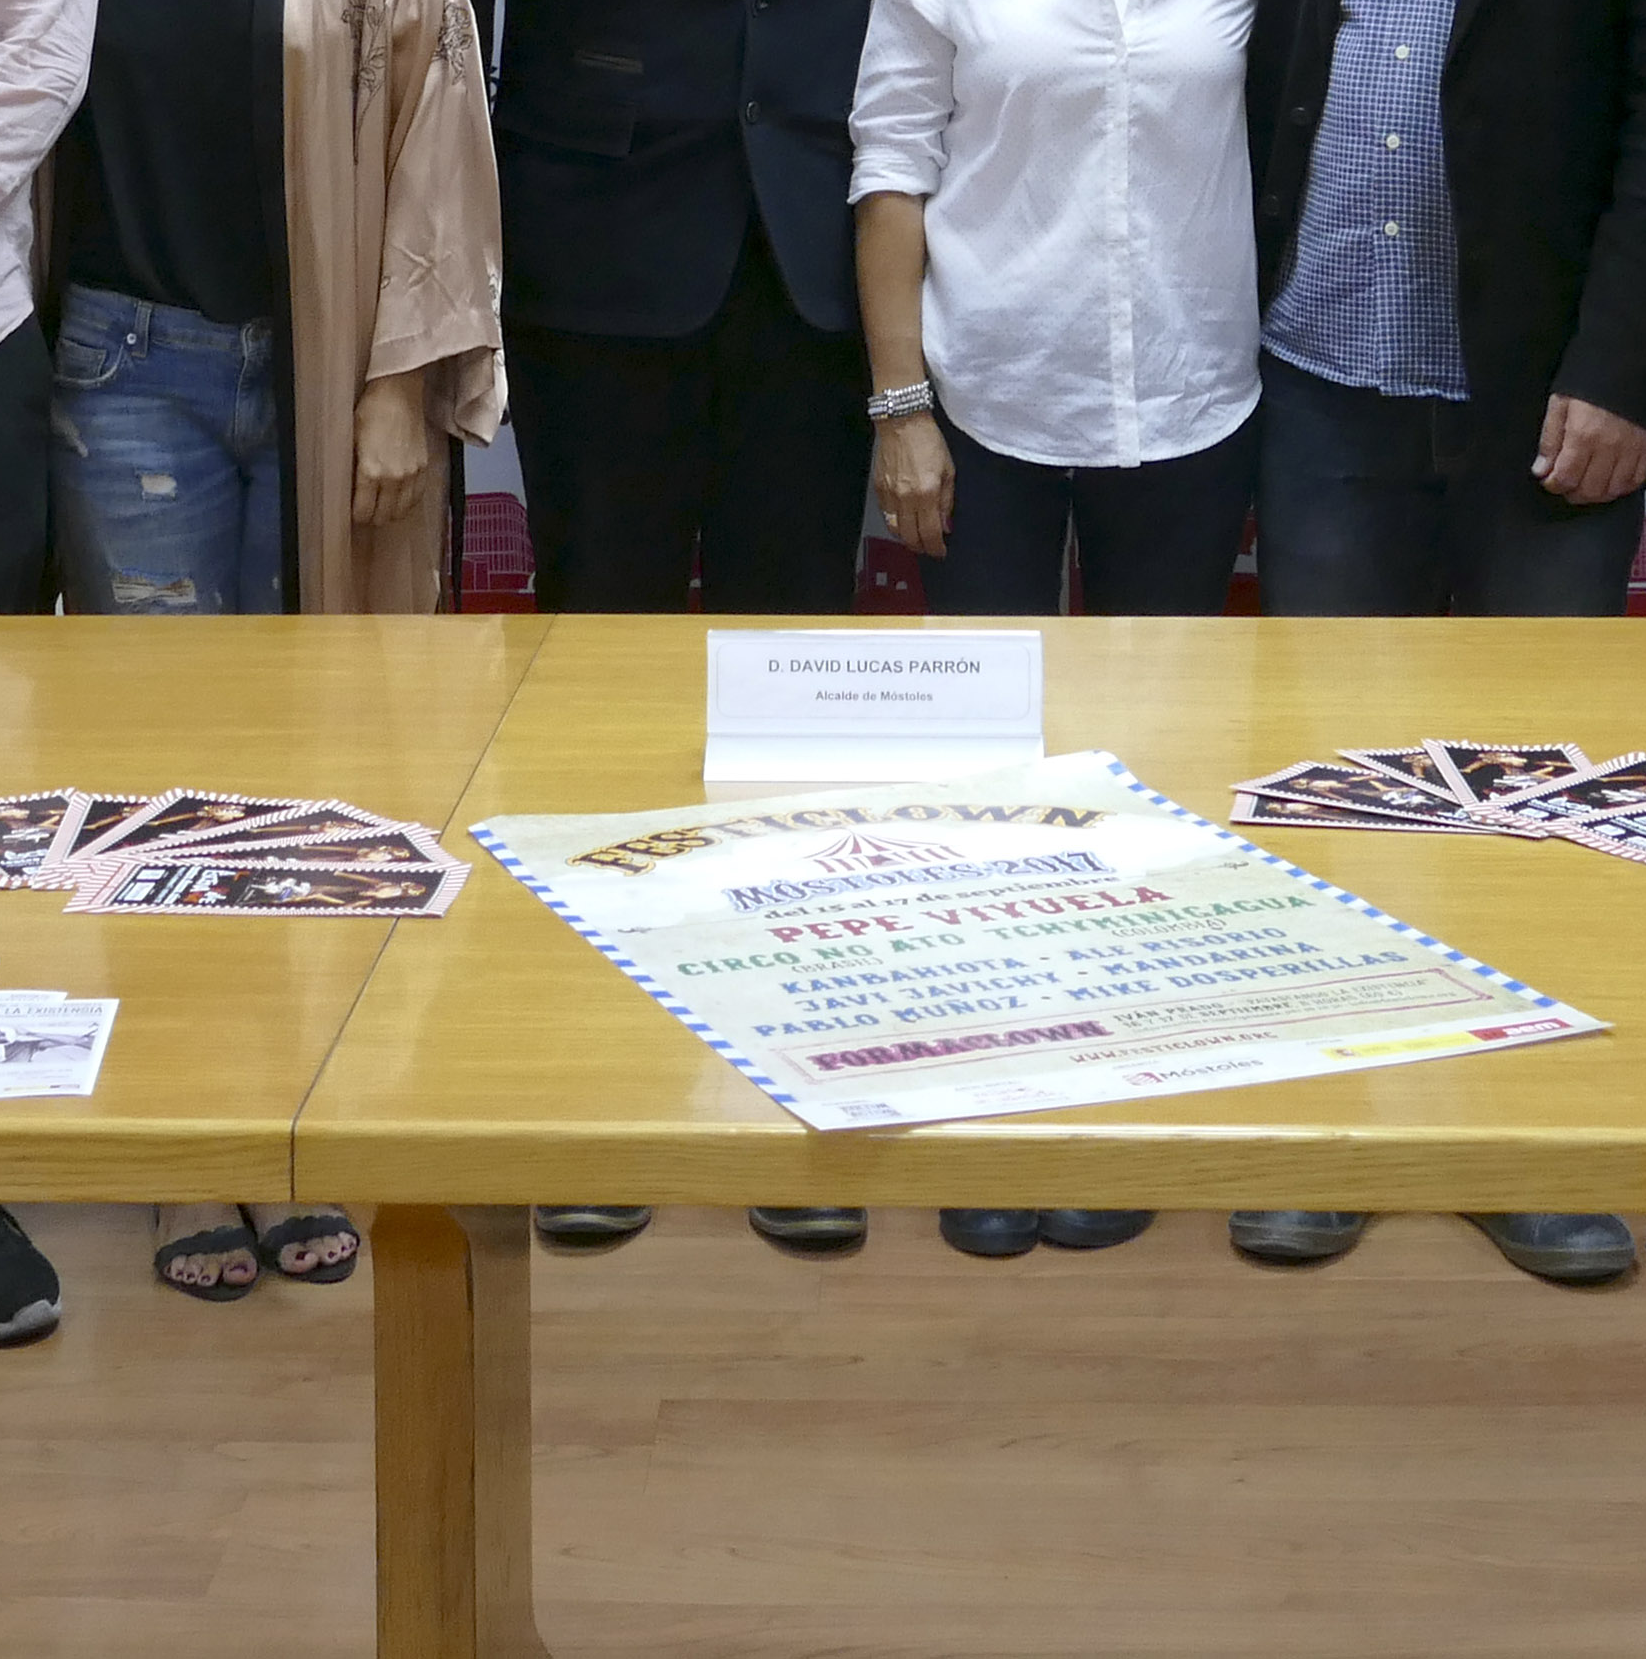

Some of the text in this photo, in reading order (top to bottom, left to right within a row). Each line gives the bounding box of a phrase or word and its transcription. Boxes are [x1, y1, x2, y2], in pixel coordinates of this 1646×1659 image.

[768, 657, 981, 674] D. DAVID LUCAS PARRÓN
[815, 691, 933, 702] Alcalde de Móstoles
[565, 806, 1117, 877] FESTICLOWN
[760, 907, 810, 918] del
[814, 903, 849, 913] 15
[846, 899, 879, 909] al
[912, 891, 951, 901] de
[954, 874, 1119, 897] septiembre
[767, 886, 1174, 943] PEPE VIYUELA
[674, 951, 804, 975] CIRCO
[813, 944, 874, 959] NO
[883, 933, 968, 951] ATO
[780, 927, 1289, 993] KANBAHIOTA ALE RISORIO
[794, 941, 1322, 1011] JAVI JAVICHY MANDARINA
[753, 950, 1410, 1037] PABLO MUÑOZ MIKE DOSPERILLAS
[1154, 1057, 1268, 1078] Móstoles
